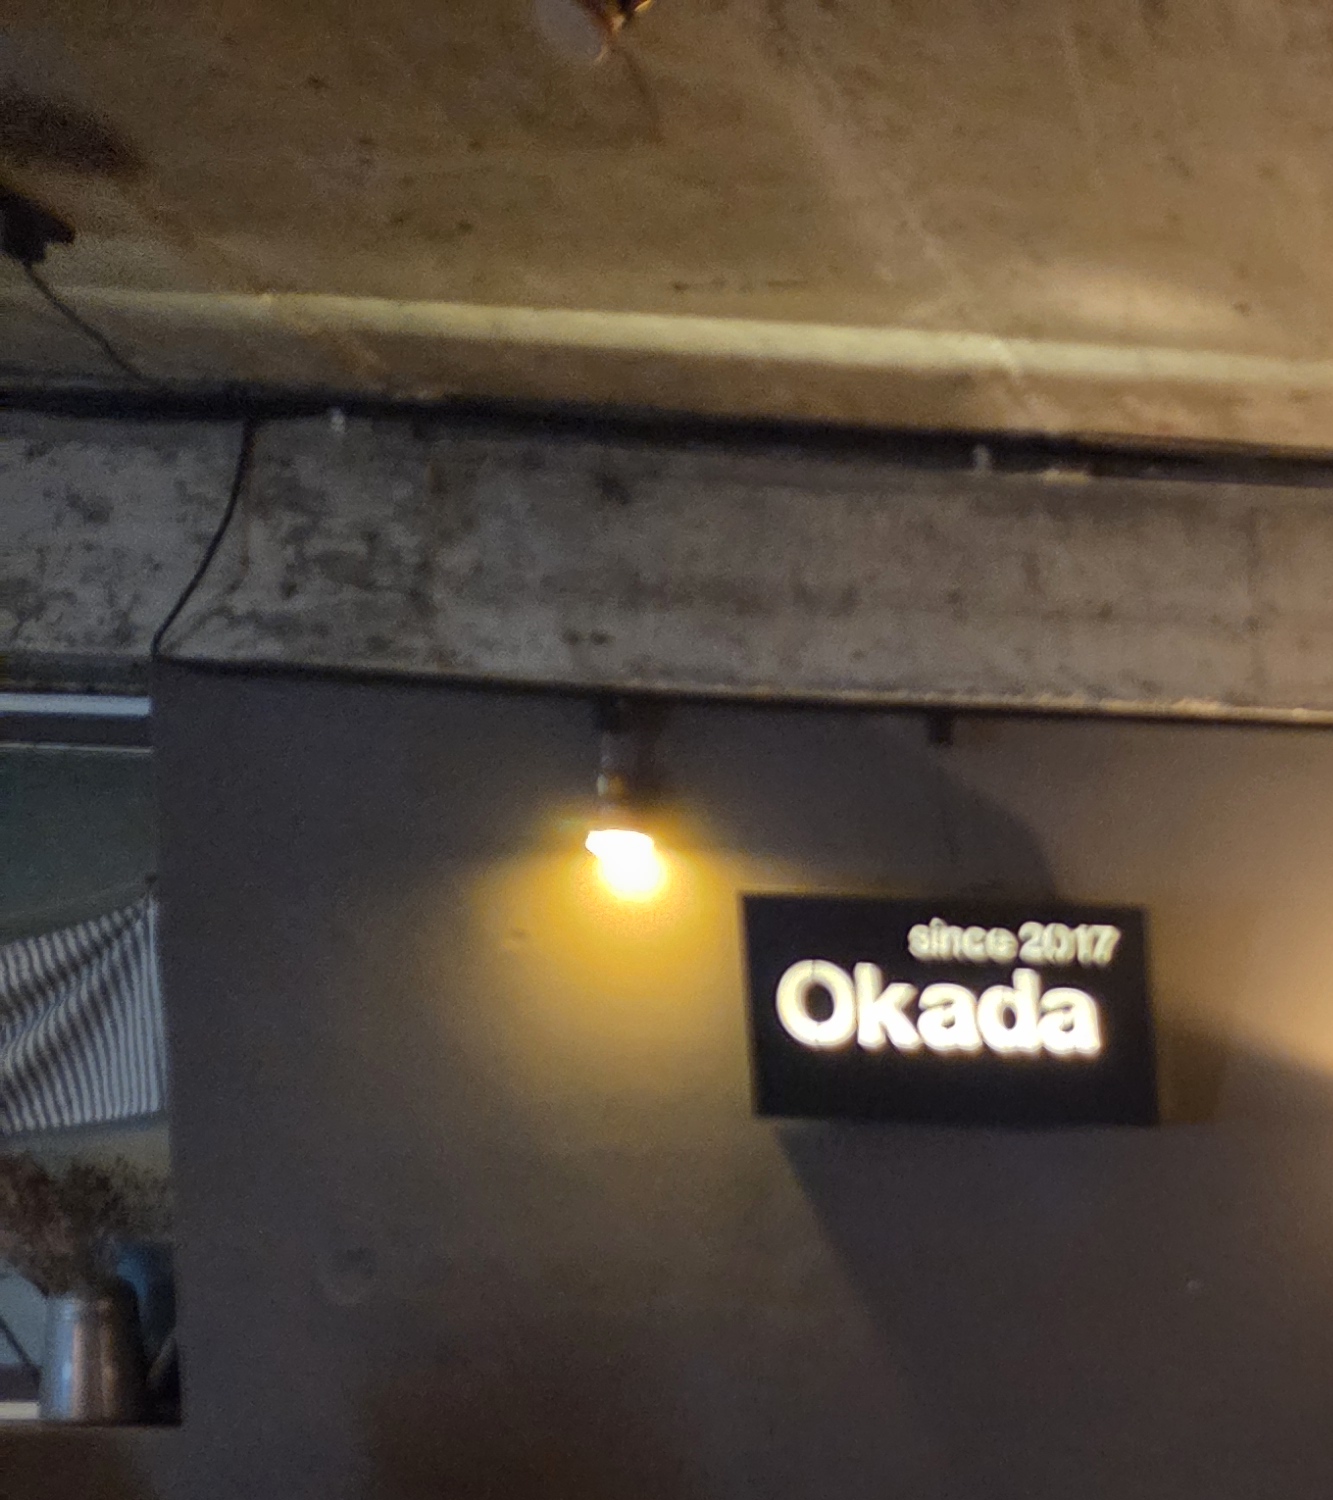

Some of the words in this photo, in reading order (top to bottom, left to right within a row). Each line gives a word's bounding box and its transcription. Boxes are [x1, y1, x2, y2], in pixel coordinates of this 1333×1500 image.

[907, 917, 1017, 963] since
[1018, 921, 1121, 966] 2017
[776, 959, 1102, 1056] Okada
